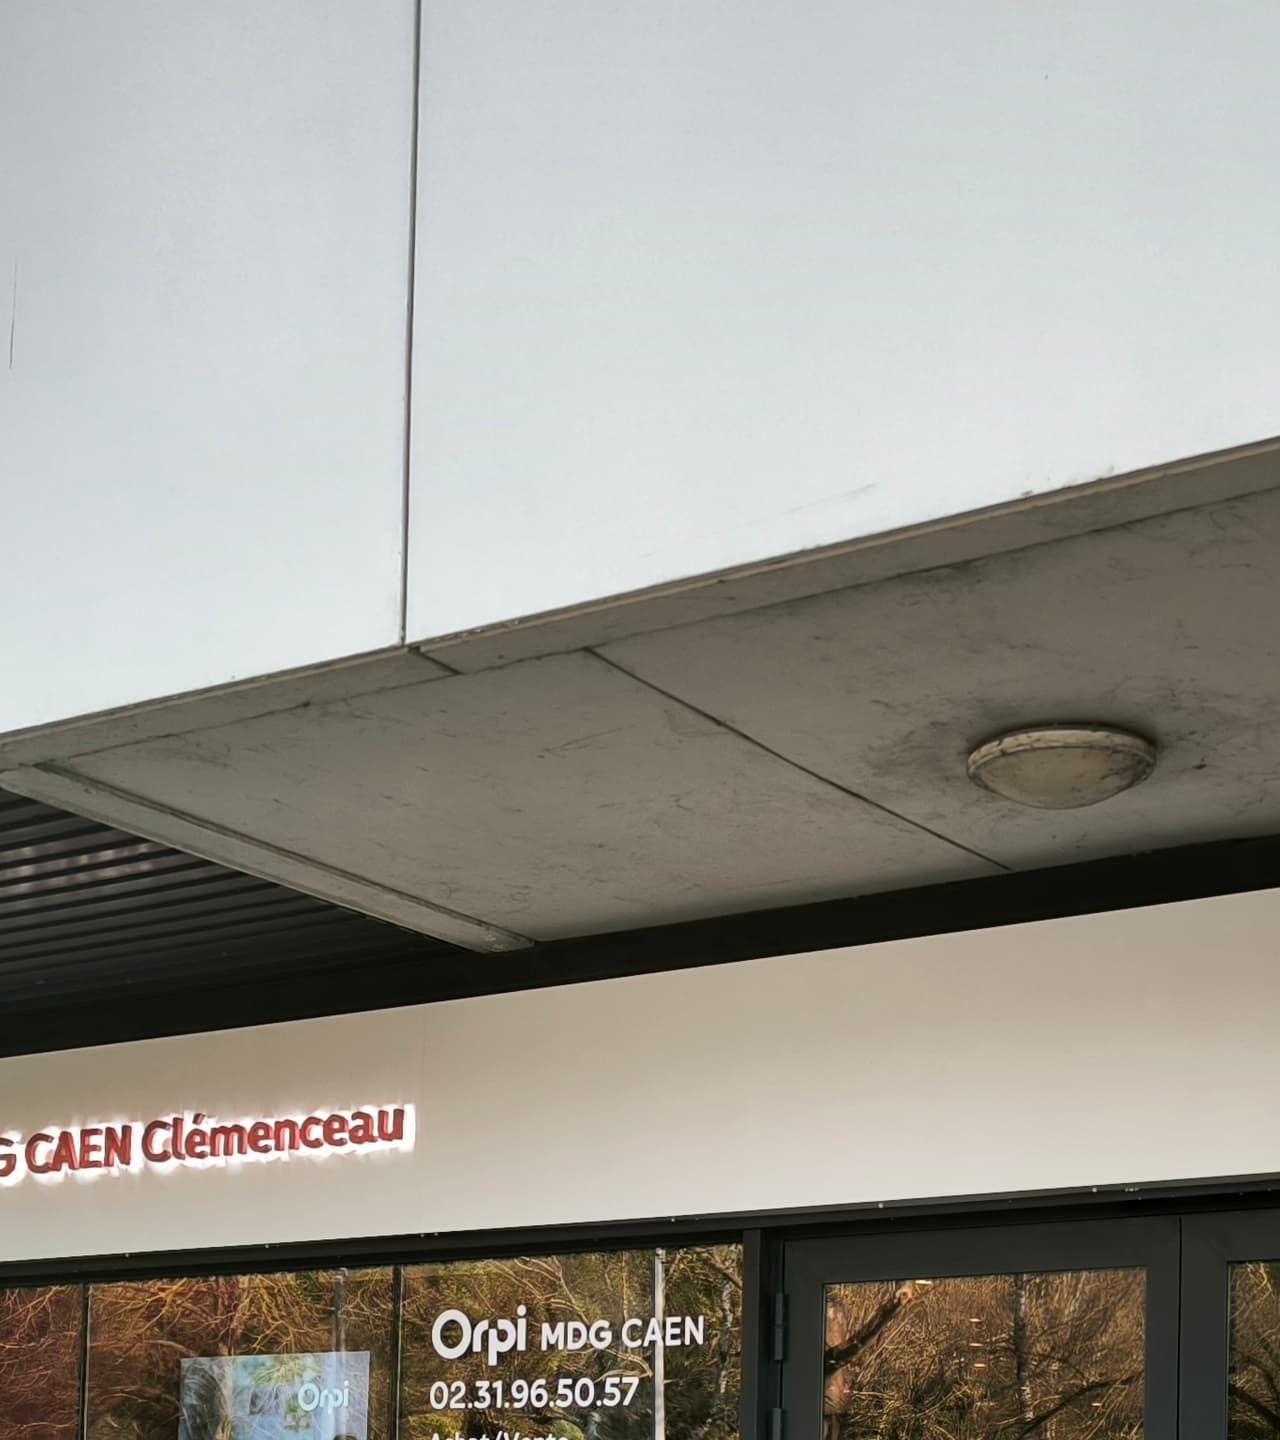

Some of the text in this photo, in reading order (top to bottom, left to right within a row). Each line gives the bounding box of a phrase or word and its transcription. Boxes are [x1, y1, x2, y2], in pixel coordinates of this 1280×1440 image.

[26, 1124, 132, 1175] CAEN
[141, 1107, 405, 1163] Clémenceau
[431, 1304, 704, 1366] Orpi MDG CAEN
[298, 1379, 349, 1414] Orpi
[429, 1376, 639, 1410] 02.31.96.50.57
